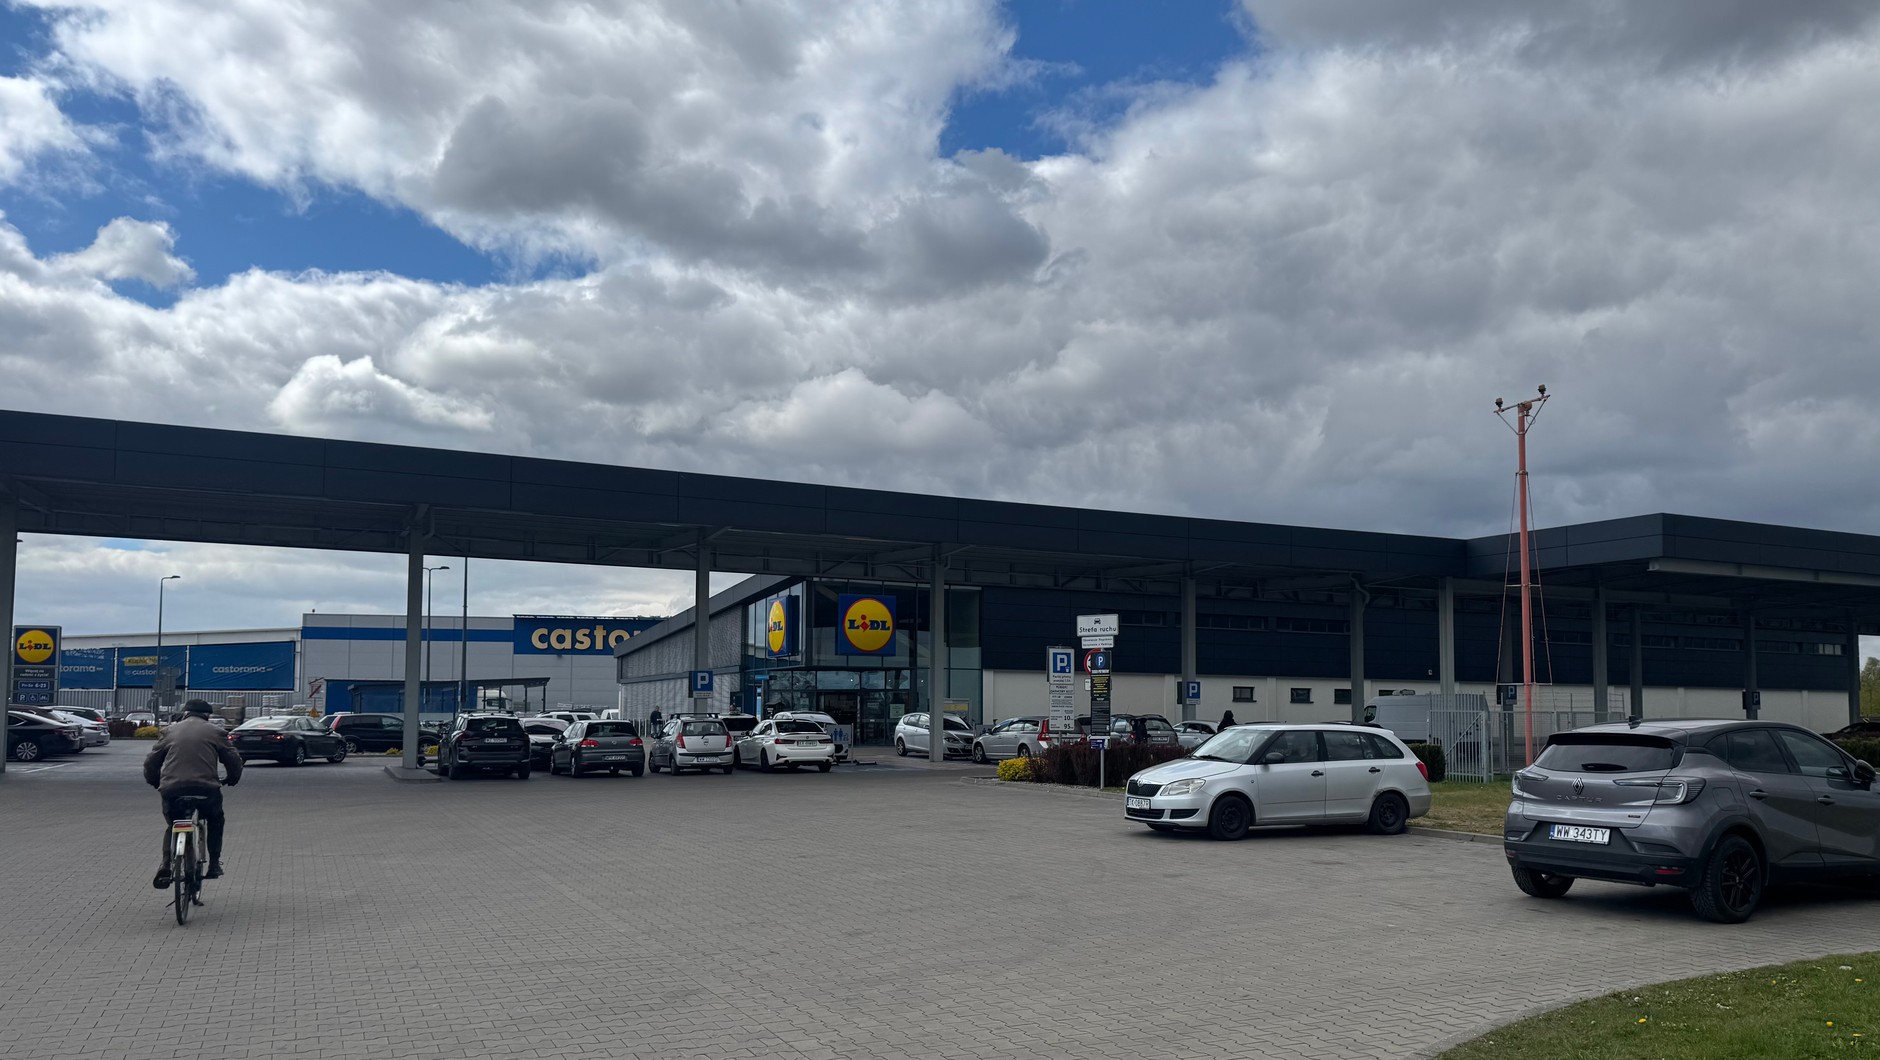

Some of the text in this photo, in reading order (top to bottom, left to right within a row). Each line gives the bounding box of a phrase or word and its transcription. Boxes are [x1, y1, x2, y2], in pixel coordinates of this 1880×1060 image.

[531, 624, 641, 650] casto
[1056, 654, 1068, 672] P
[1098, 656, 1104, 666] P
[697, 672, 710, 689] P
[1189, 683, 1198, 697] P
[1508, 685, 1515, 698] P
[1556, 794, 1603, 803] CAPTUR
[1556, 825, 1608, 841] WW 343TY
